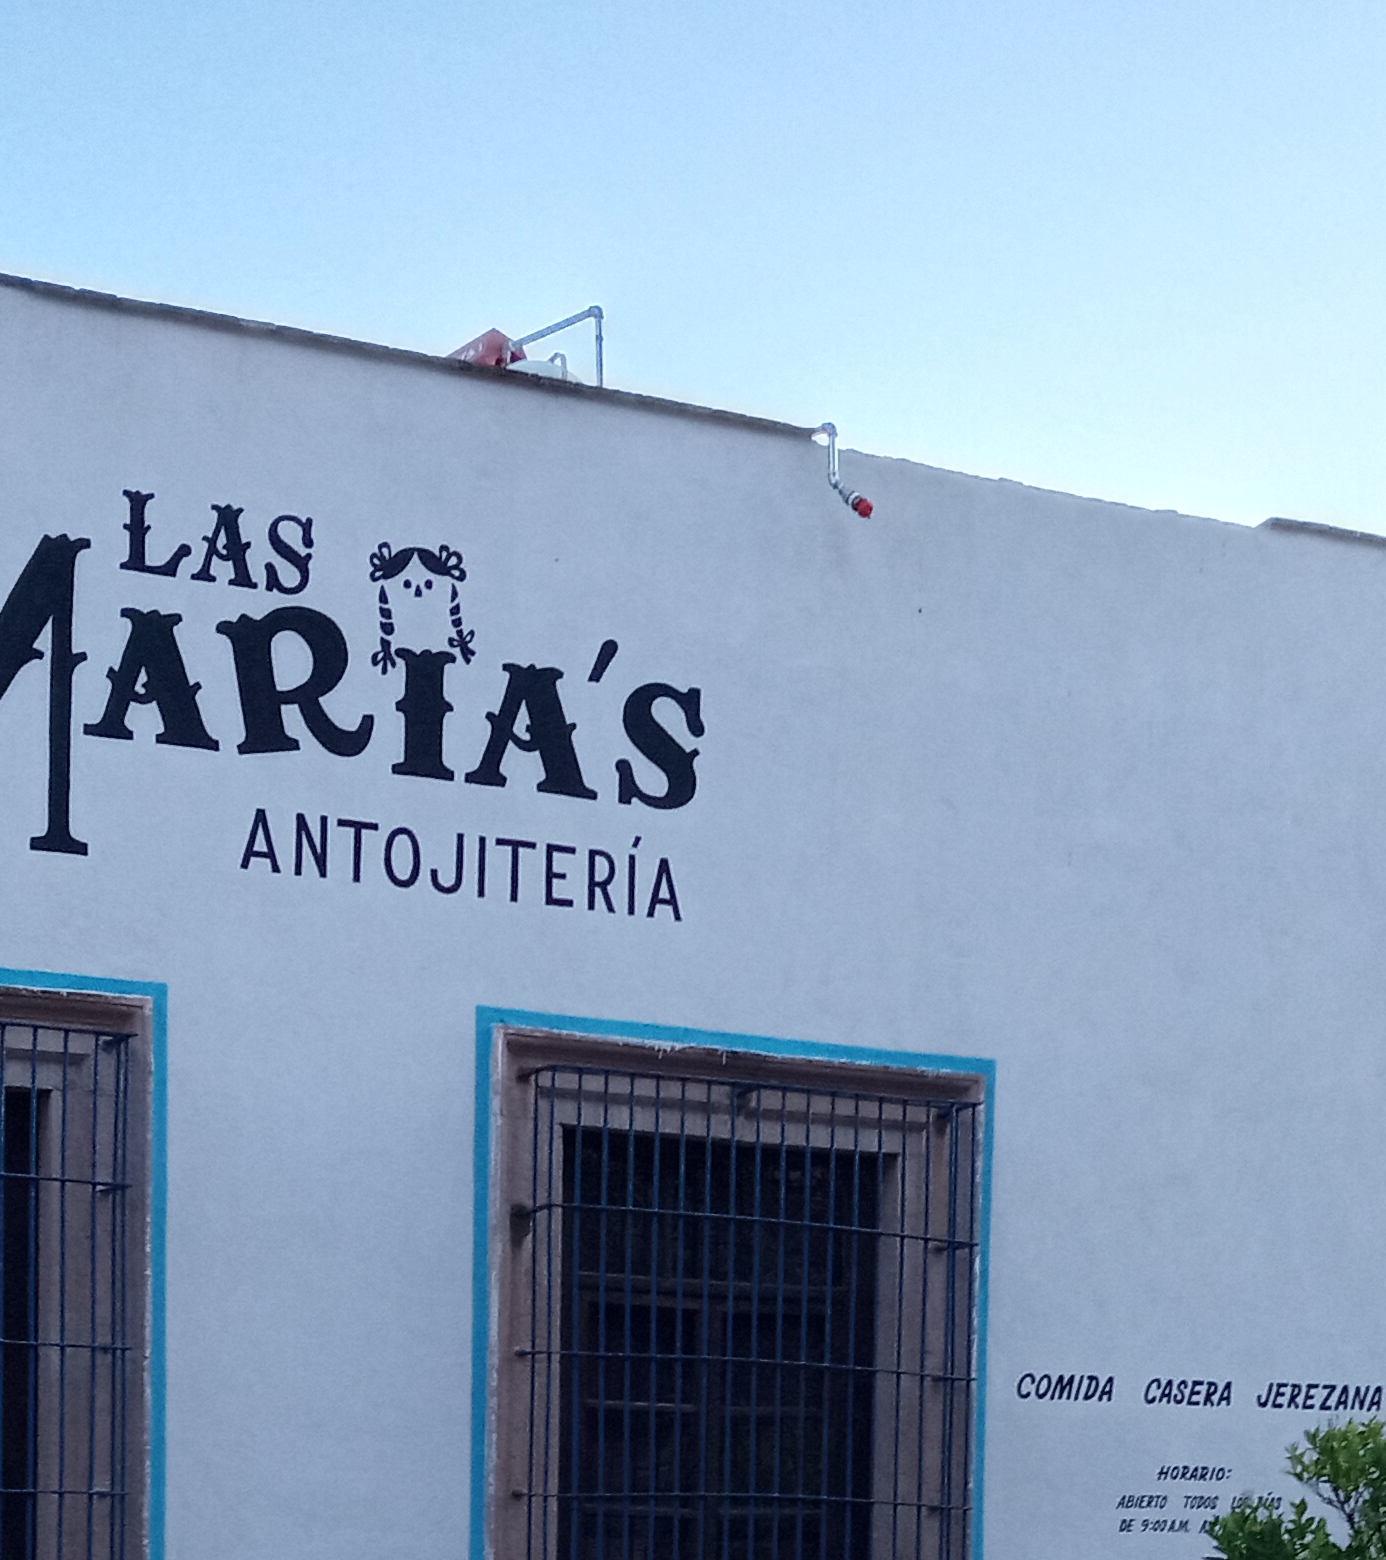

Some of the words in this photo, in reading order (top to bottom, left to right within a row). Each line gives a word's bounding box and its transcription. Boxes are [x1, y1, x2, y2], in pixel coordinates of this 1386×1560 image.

[119, 489, 315, 596] LAS
[240, 807, 683, 922] ANTOJITERÍA
[1016, 1372, 1115, 1402] COMIDA
[1143, 1377, 1233, 1407] CASERA
[1256, 1381, 1383, 1413] JEREZANA
[1156, 1465, 1233, 1482] HORARIO:
[1115, 1494, 1168, 1510] ABIERTO
[1183, 1495, 1220, 1511] TODOS
[1118, 1518, 1136, 1533] DE
